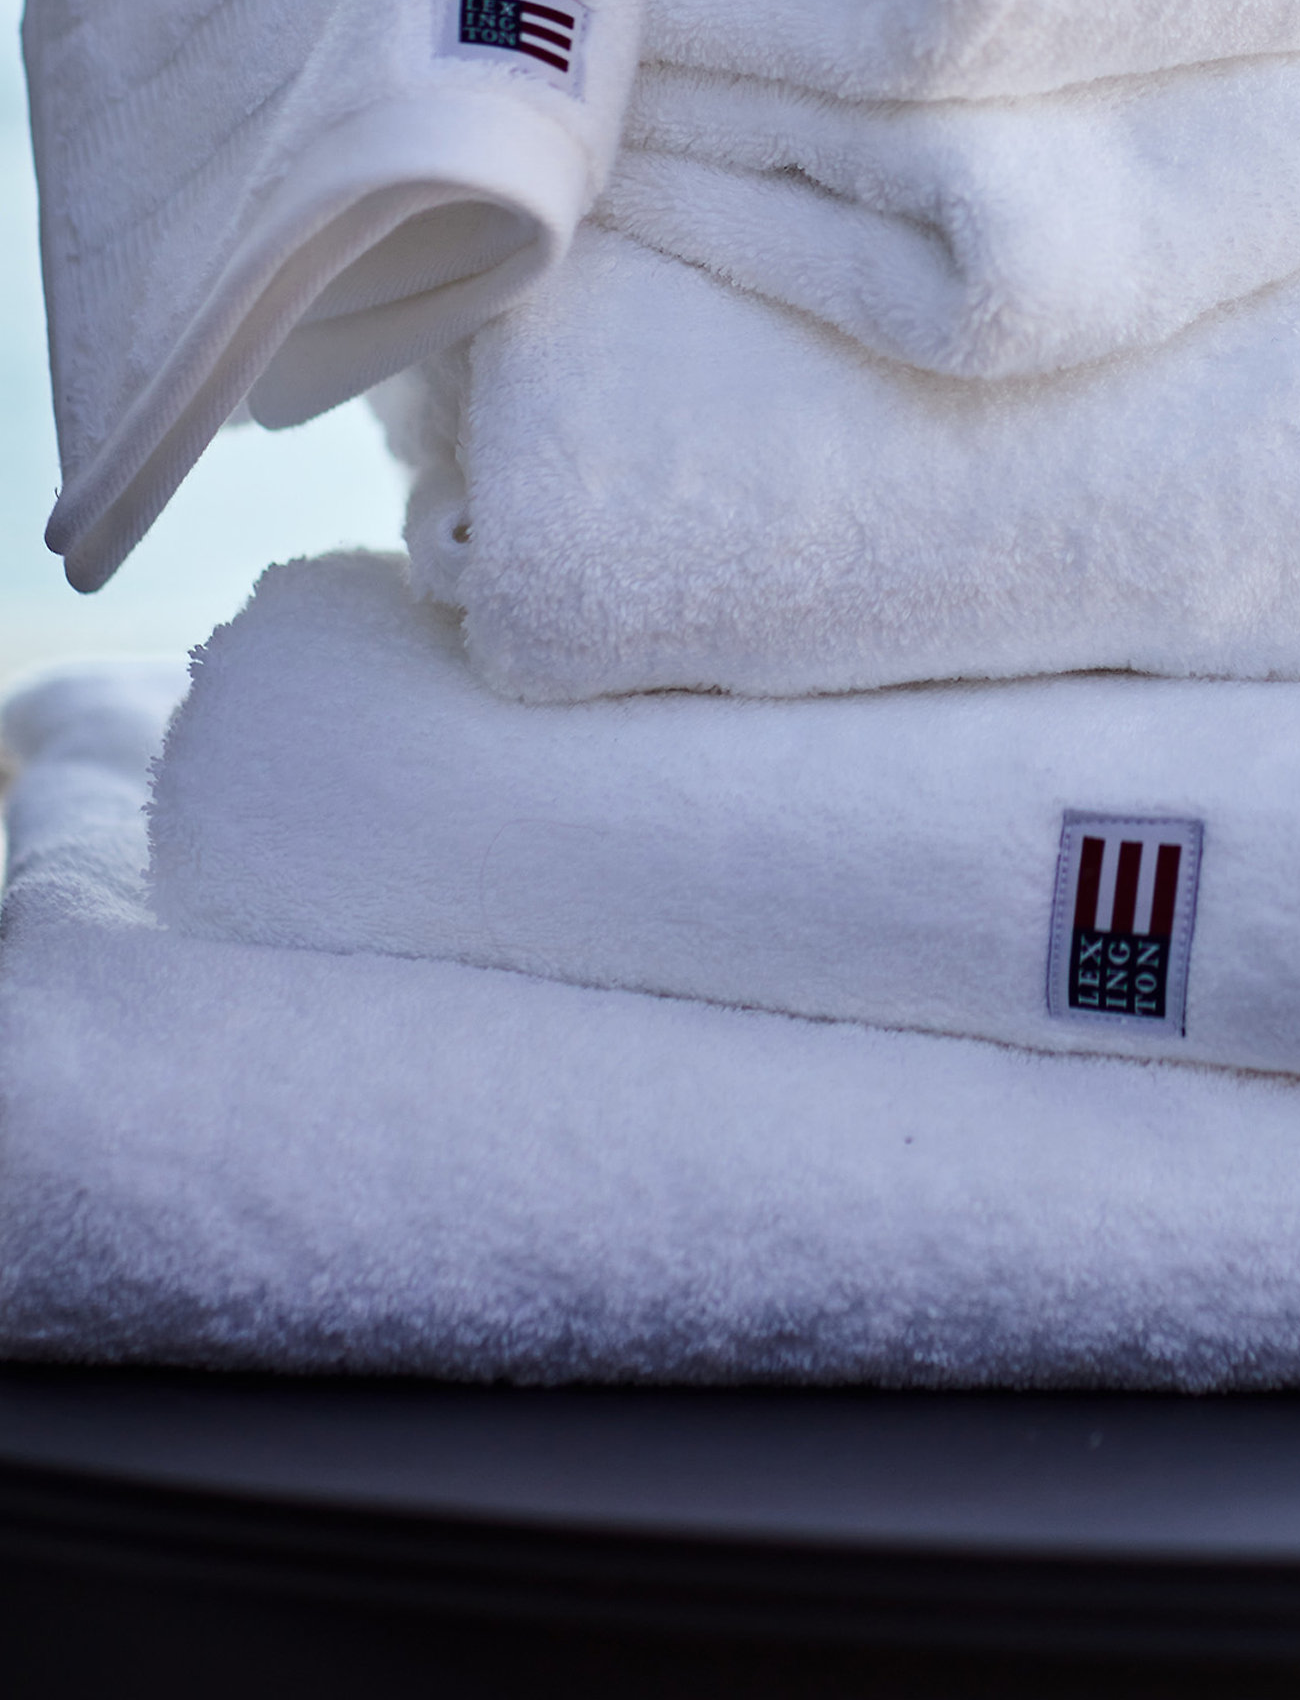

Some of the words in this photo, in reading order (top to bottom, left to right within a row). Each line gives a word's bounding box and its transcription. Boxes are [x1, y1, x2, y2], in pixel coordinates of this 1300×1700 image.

[463, 27, 516, 46] TON
[466, 13, 515, 31] ING
[1078, 933, 1103, 1006] LEX
[1106, 940, 1131, 1008] ING
[1134, 941, 1160, 1015] TON
